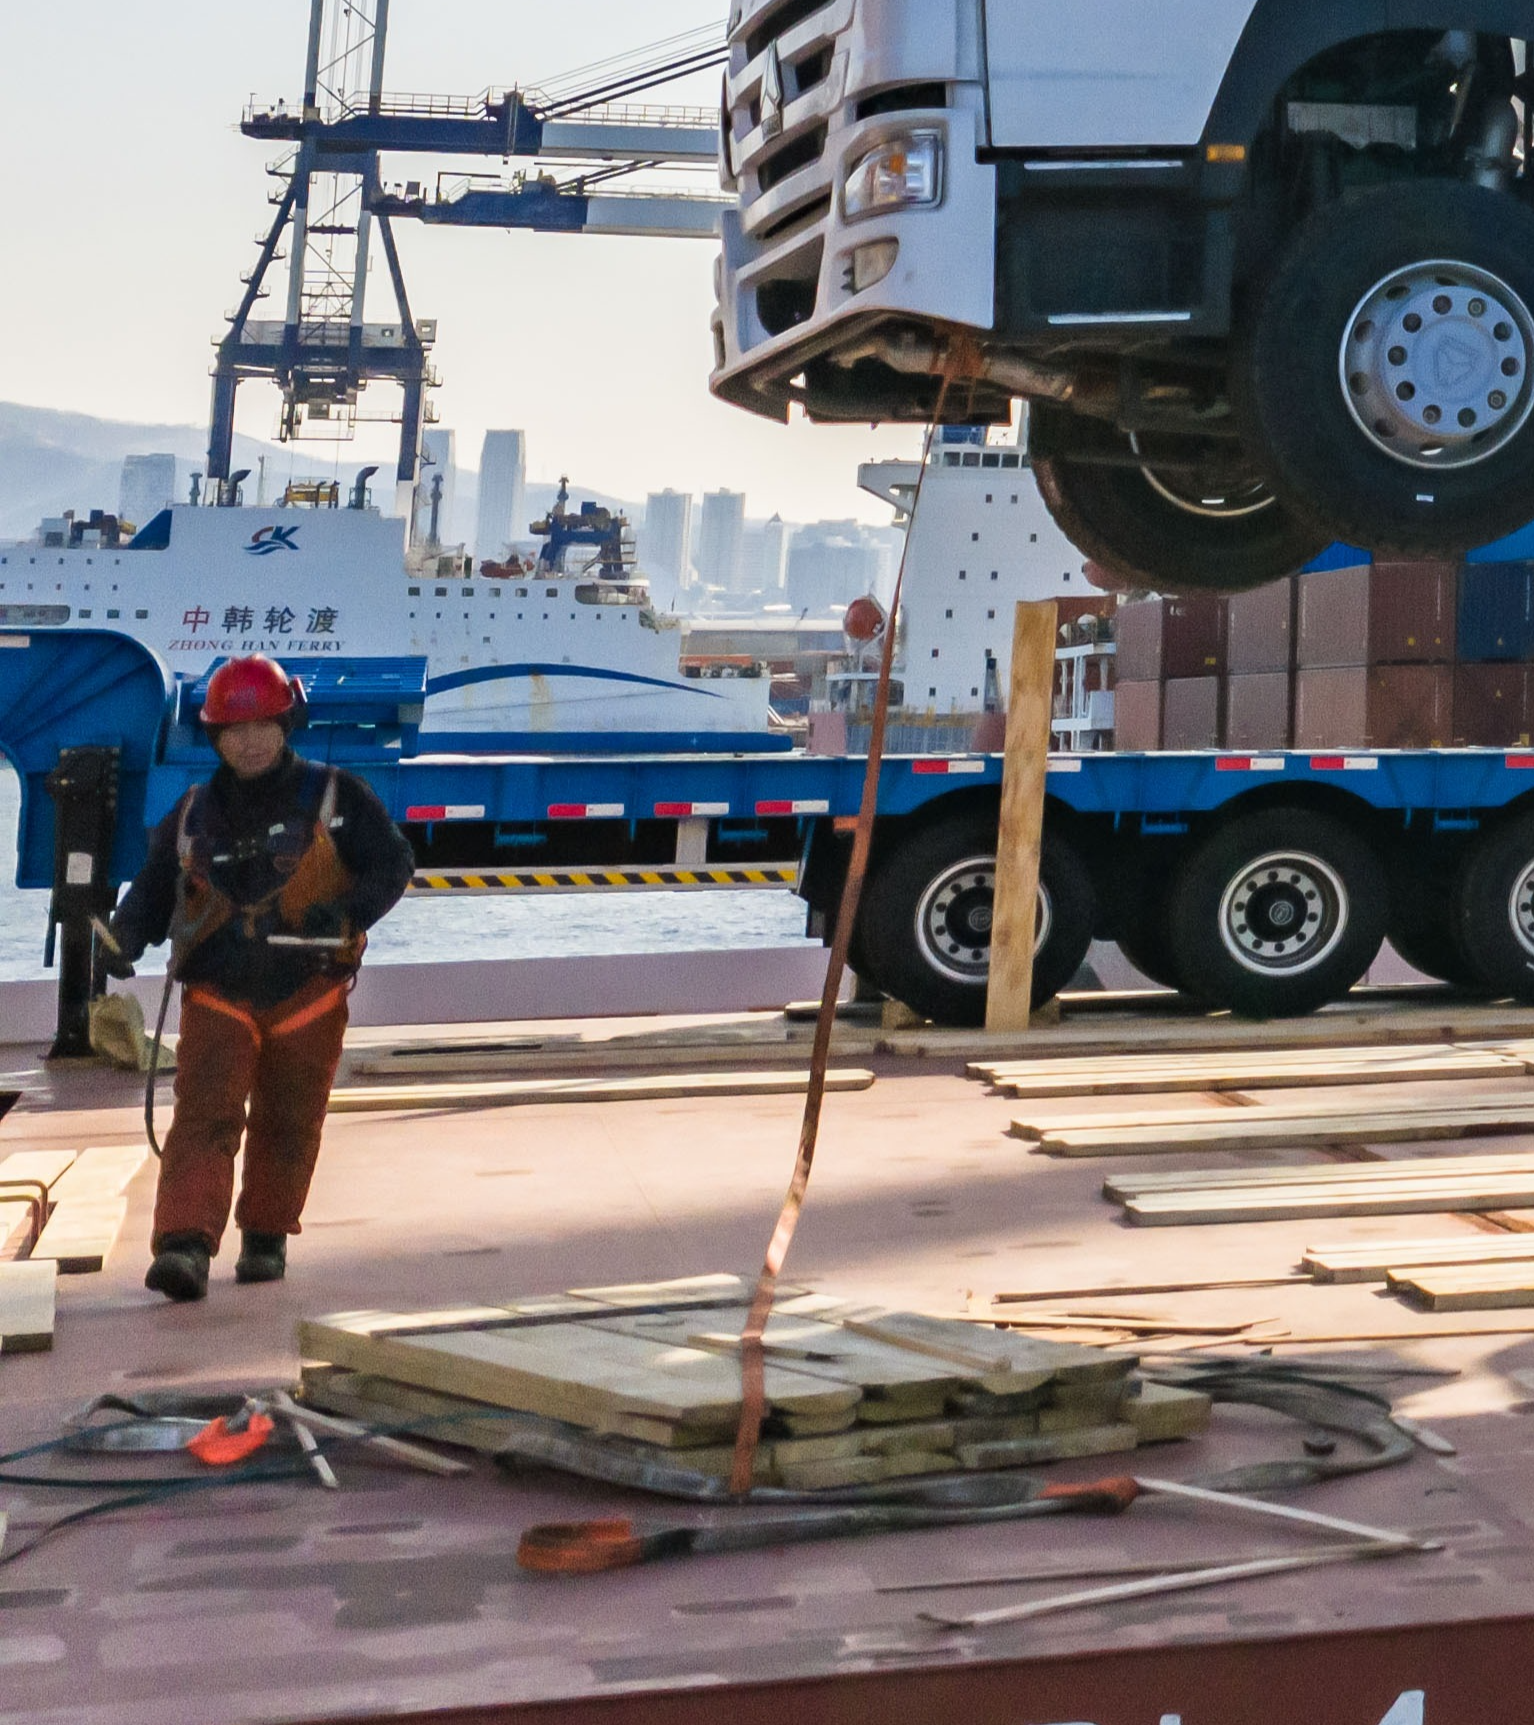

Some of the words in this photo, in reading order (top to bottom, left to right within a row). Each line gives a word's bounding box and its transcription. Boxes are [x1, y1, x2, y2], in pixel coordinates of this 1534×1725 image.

[182, 605, 338, 634] 中韩轮渡
[168, 640, 233, 651] ZHONG
[241, 640, 279, 651] HAN
[288, 640, 346, 651] FERRY
